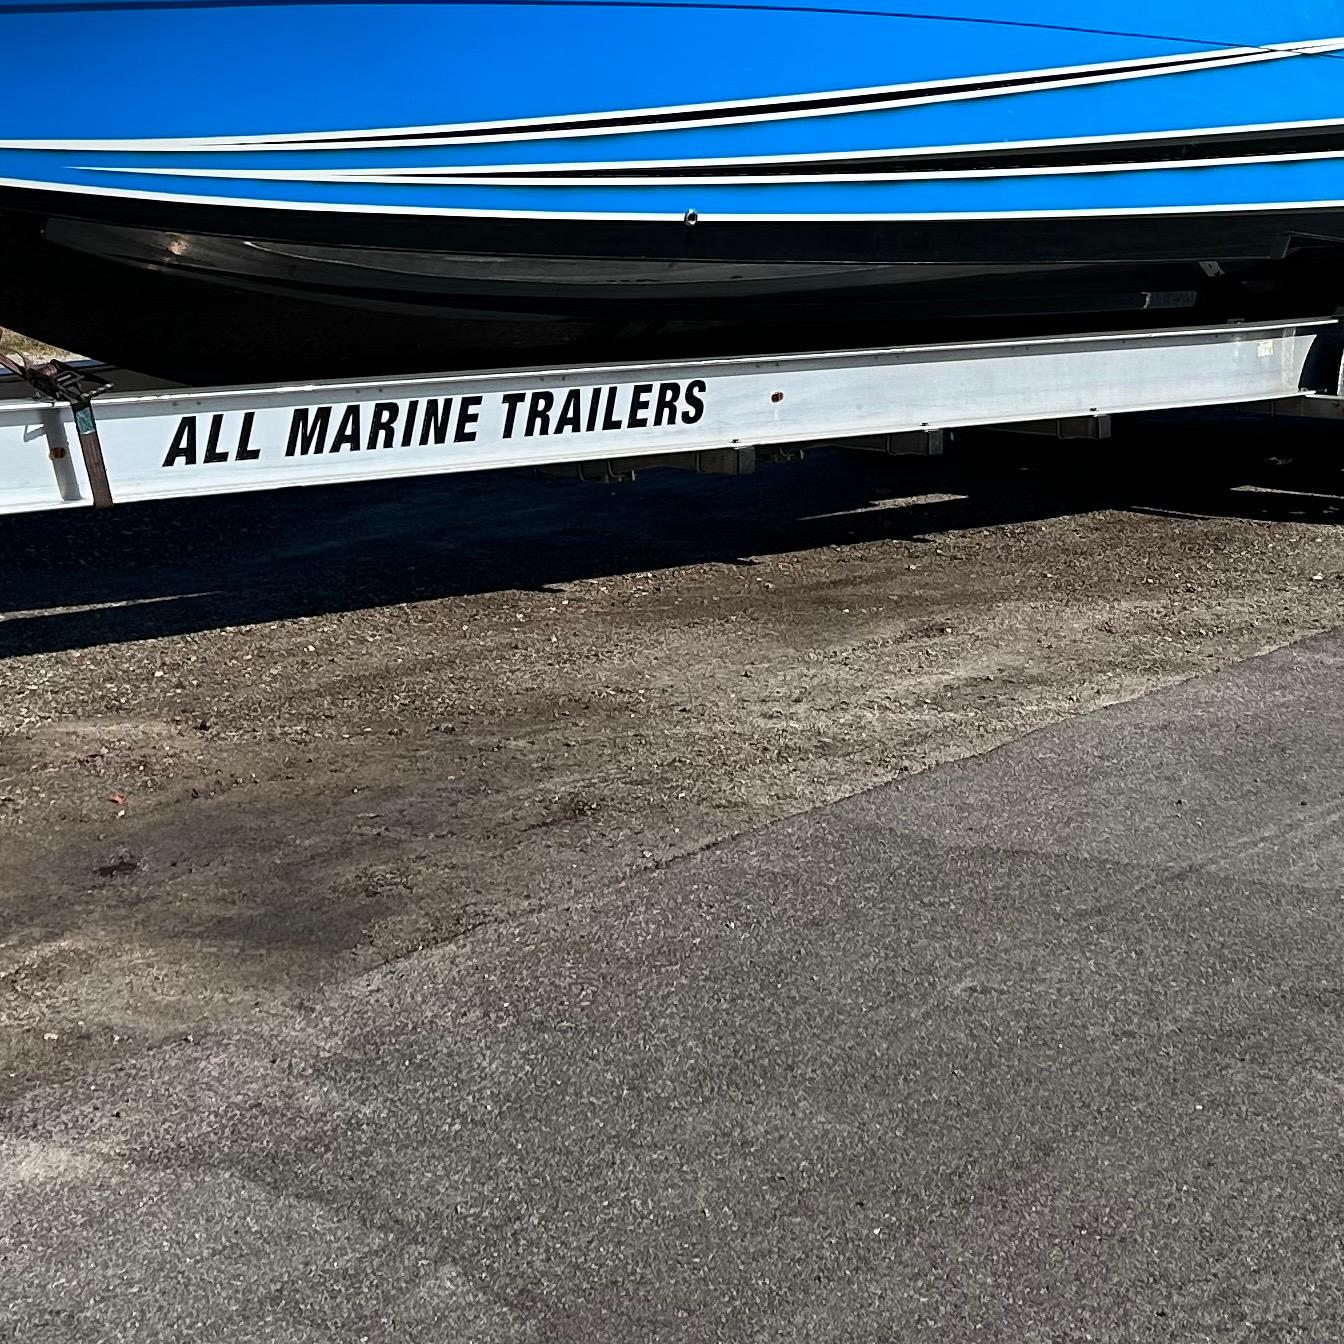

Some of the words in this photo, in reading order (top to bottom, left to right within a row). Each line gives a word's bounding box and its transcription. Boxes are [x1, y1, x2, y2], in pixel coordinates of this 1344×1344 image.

[162, 411, 261, 467] ALL
[285, 395, 483, 457] MARINE
[501, 379, 707, 439] TRAILERS
